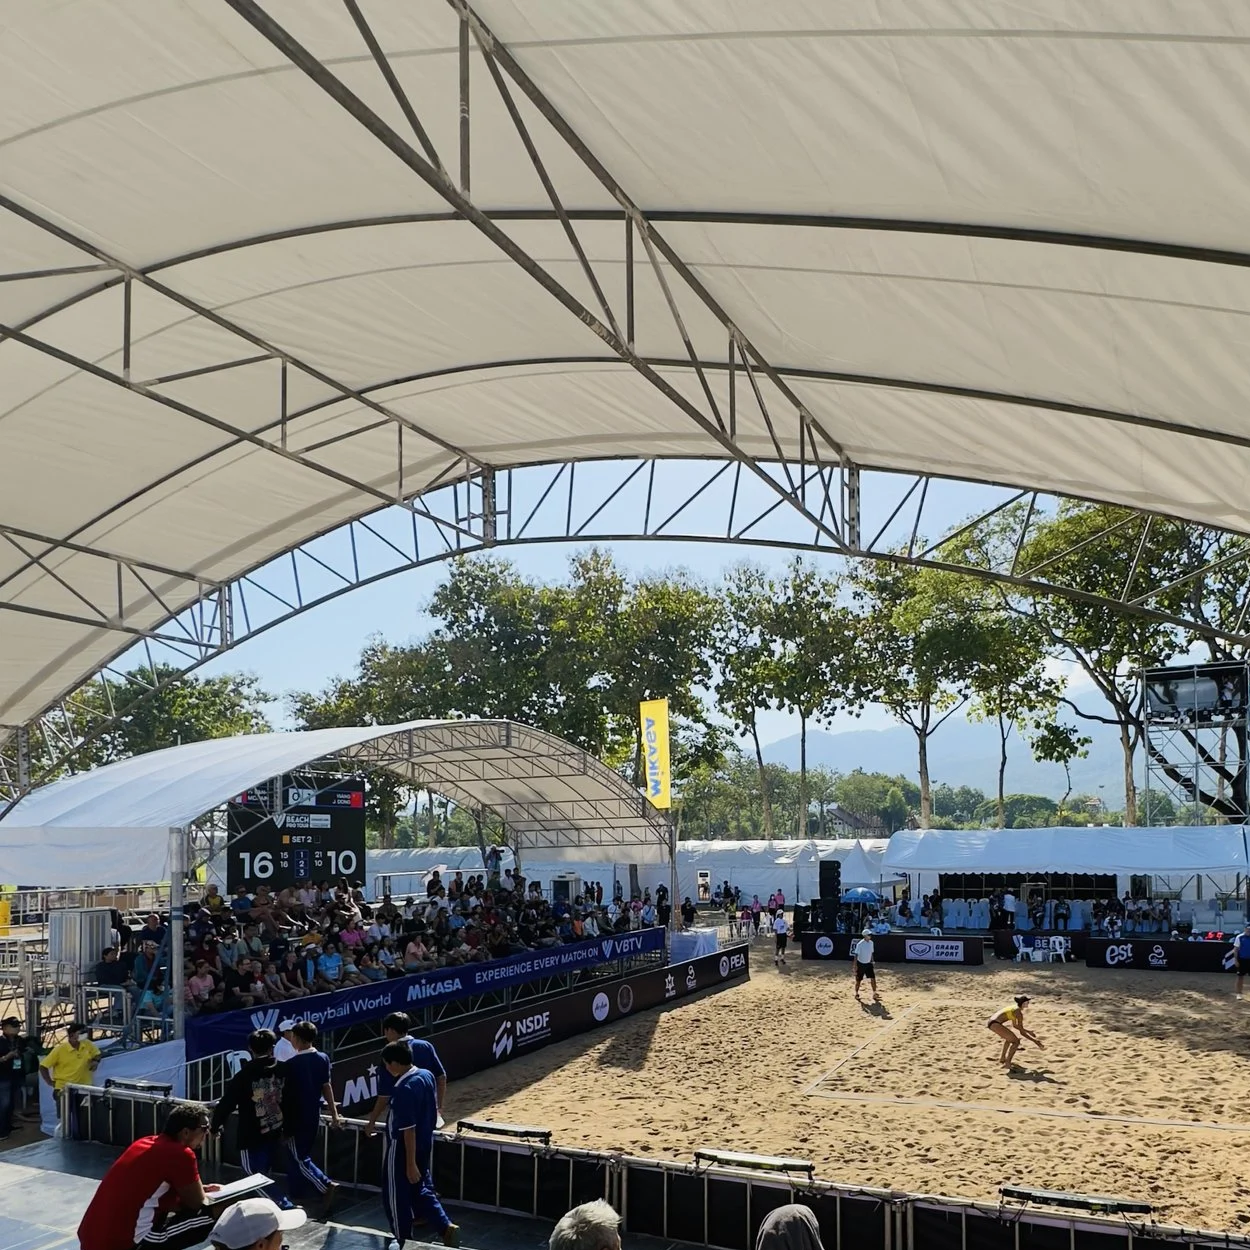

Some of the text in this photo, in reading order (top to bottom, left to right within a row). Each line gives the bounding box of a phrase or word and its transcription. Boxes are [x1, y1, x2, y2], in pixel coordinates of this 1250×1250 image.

[240, 852, 274, 878] 16
[327, 850, 357, 875] 10
[615, 936, 643, 953] VBTV
[1106, 943, 1133, 964] est
[476, 947, 598, 984] EXPERIENCE EVERY MATCH ON
[730, 954, 745, 968] PEA
[283, 993, 391, 1024] Volleyball World
[516, 1012, 550, 1036] NSDF
